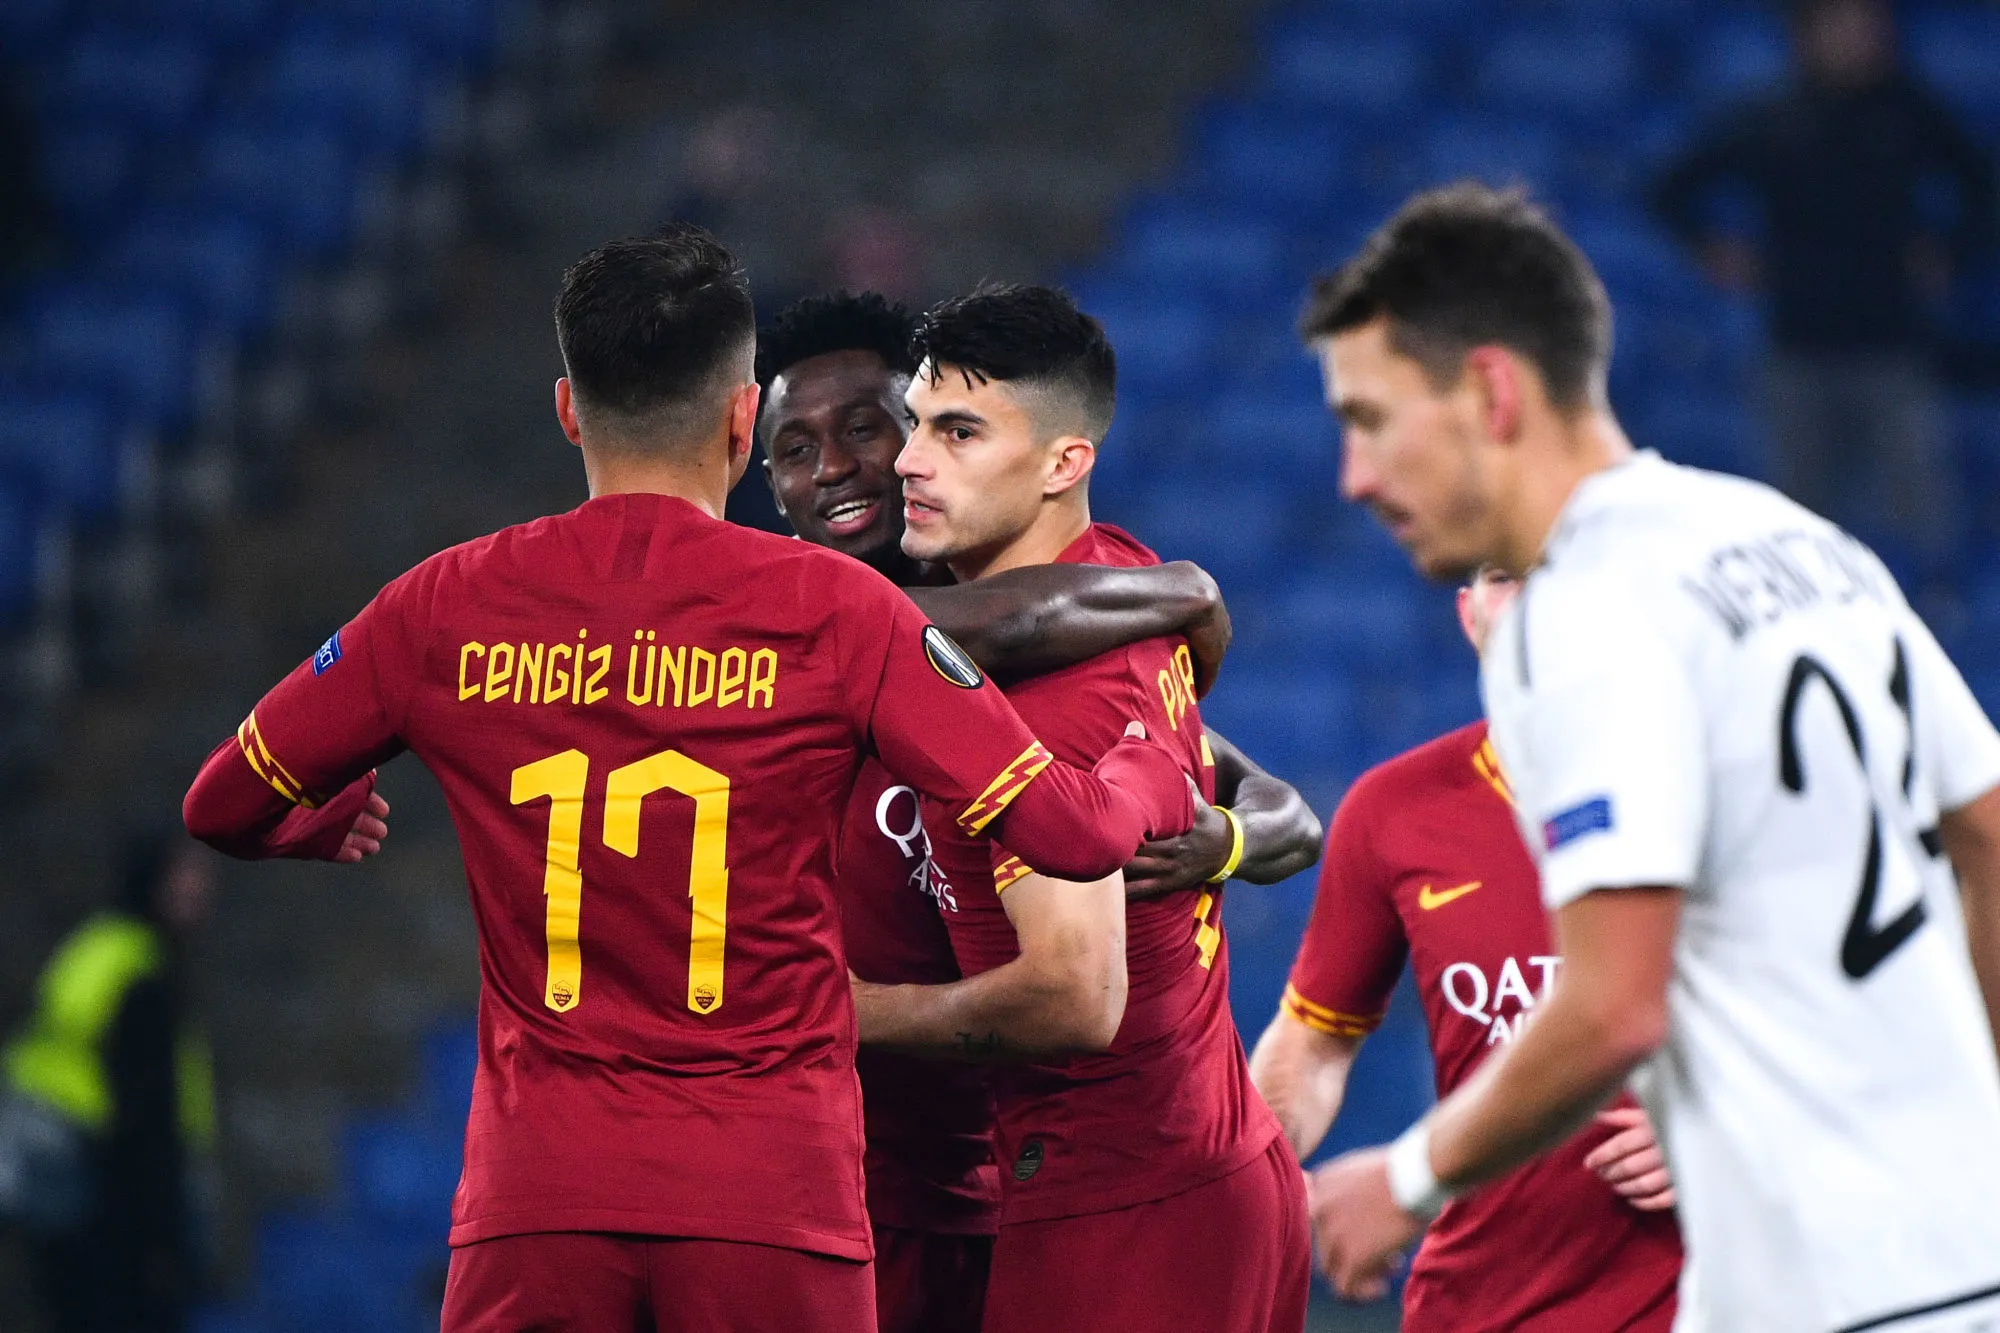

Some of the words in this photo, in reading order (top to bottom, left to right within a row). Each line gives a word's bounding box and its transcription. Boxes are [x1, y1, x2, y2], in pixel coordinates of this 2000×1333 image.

[625, 628, 778, 709] ÜNDER
[509, 748, 731, 1015] 17
[1440, 955, 1566, 1027] QAT
